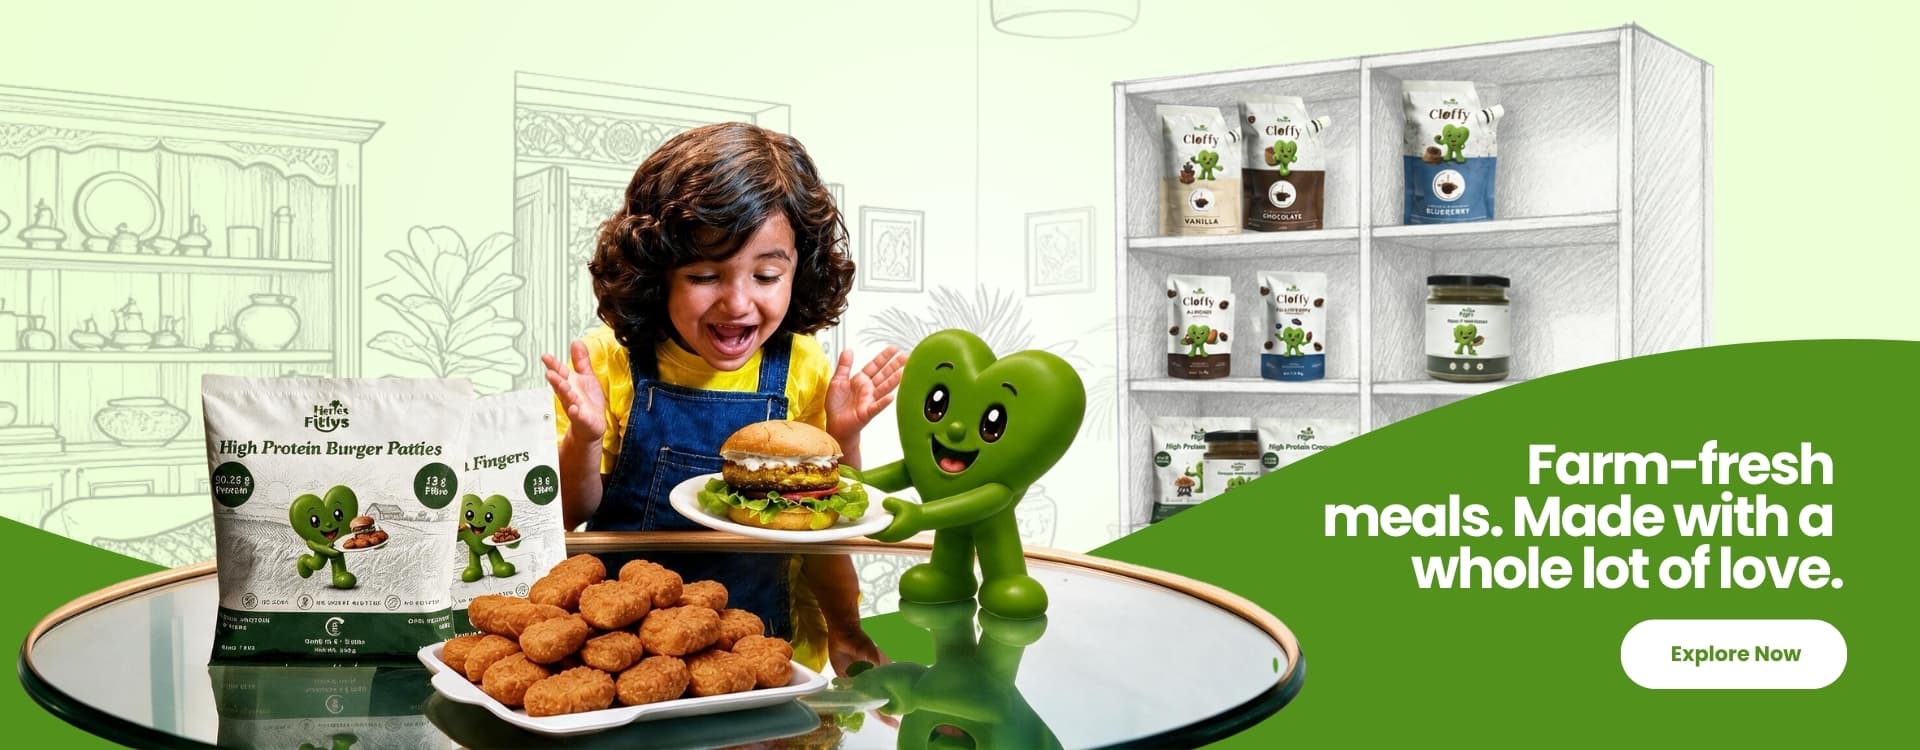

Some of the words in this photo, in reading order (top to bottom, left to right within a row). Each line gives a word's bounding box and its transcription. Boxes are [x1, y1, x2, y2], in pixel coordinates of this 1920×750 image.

[219, 440, 258, 458] High
[262, 441, 321, 455] Protein
[325, 441, 383, 459] Burger
[387, 441, 442, 456] Patties
[472, 451, 530, 471] Fingers
